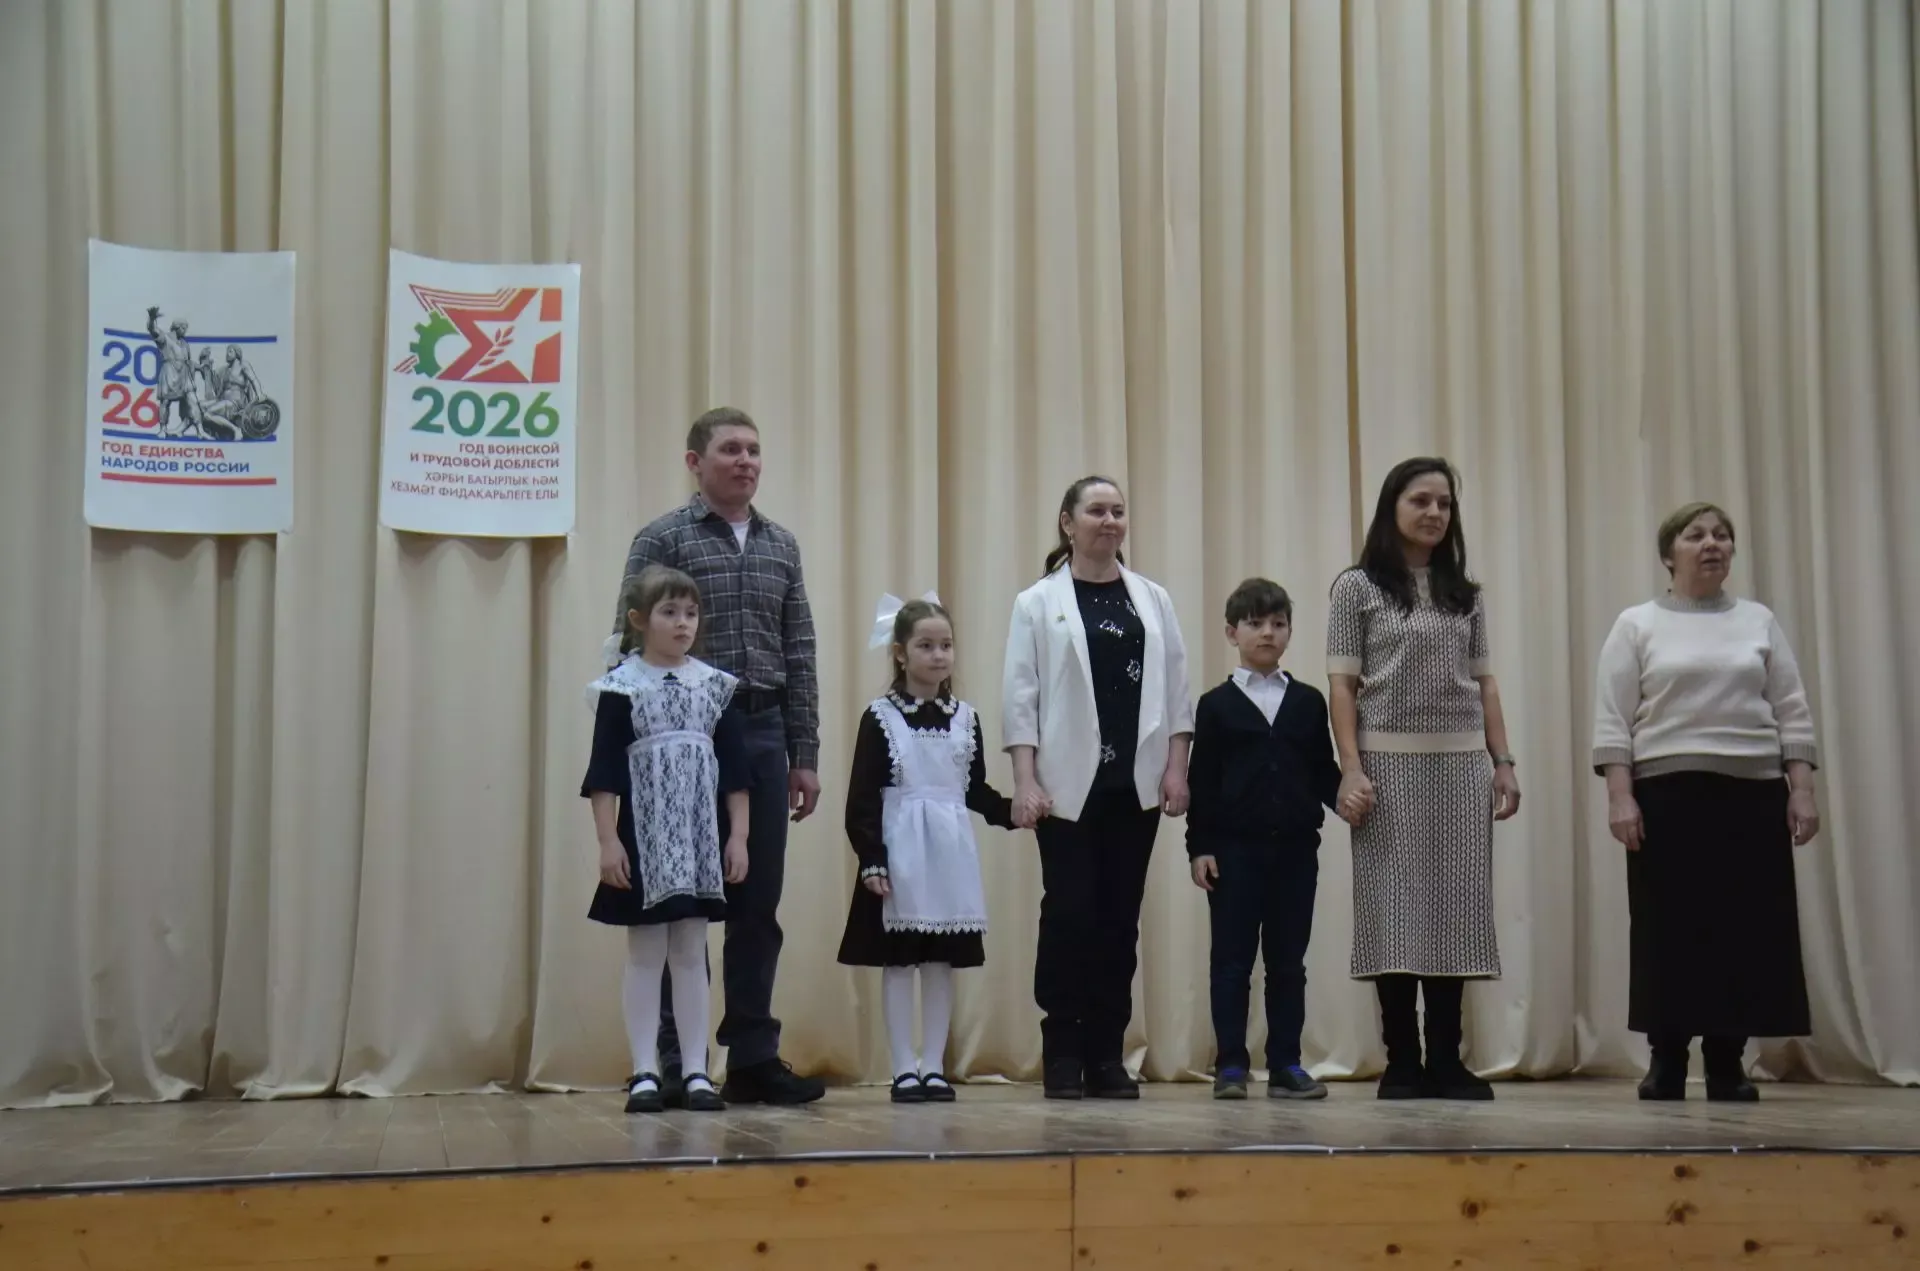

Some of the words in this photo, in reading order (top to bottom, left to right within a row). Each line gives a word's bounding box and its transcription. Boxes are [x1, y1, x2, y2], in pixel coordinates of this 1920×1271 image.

[102, 340, 161, 386] 20
[102, 383, 160, 428] 26
[411, 386, 560, 438] 2026
[102, 440, 133, 456] ГОД
[139, 445, 225, 459] ЕДИНСТВА
[459, 443, 485, 455] ГОД
[488, 442, 560, 455] ВОИНСКОЙ
[101, 456, 179, 472] НАРОДОВ
[184, 462, 250, 473] РОССИИ
[410, 453, 419, 462] И
[423, 453, 491, 468] ТРУДОВОЙ
[493, 458, 560, 470] ДОБЛЕСТИ
[425, 471, 464, 484] ХӘРБИ
[467, 474, 529, 486] БАТЫРЛЫК
[391, 480, 435, 496] ХЕЗМӘТ
[438, 486, 533, 500] ФИДАКАРЬЛЕГЕ
[535, 489, 559, 500] ЕЛЫ
